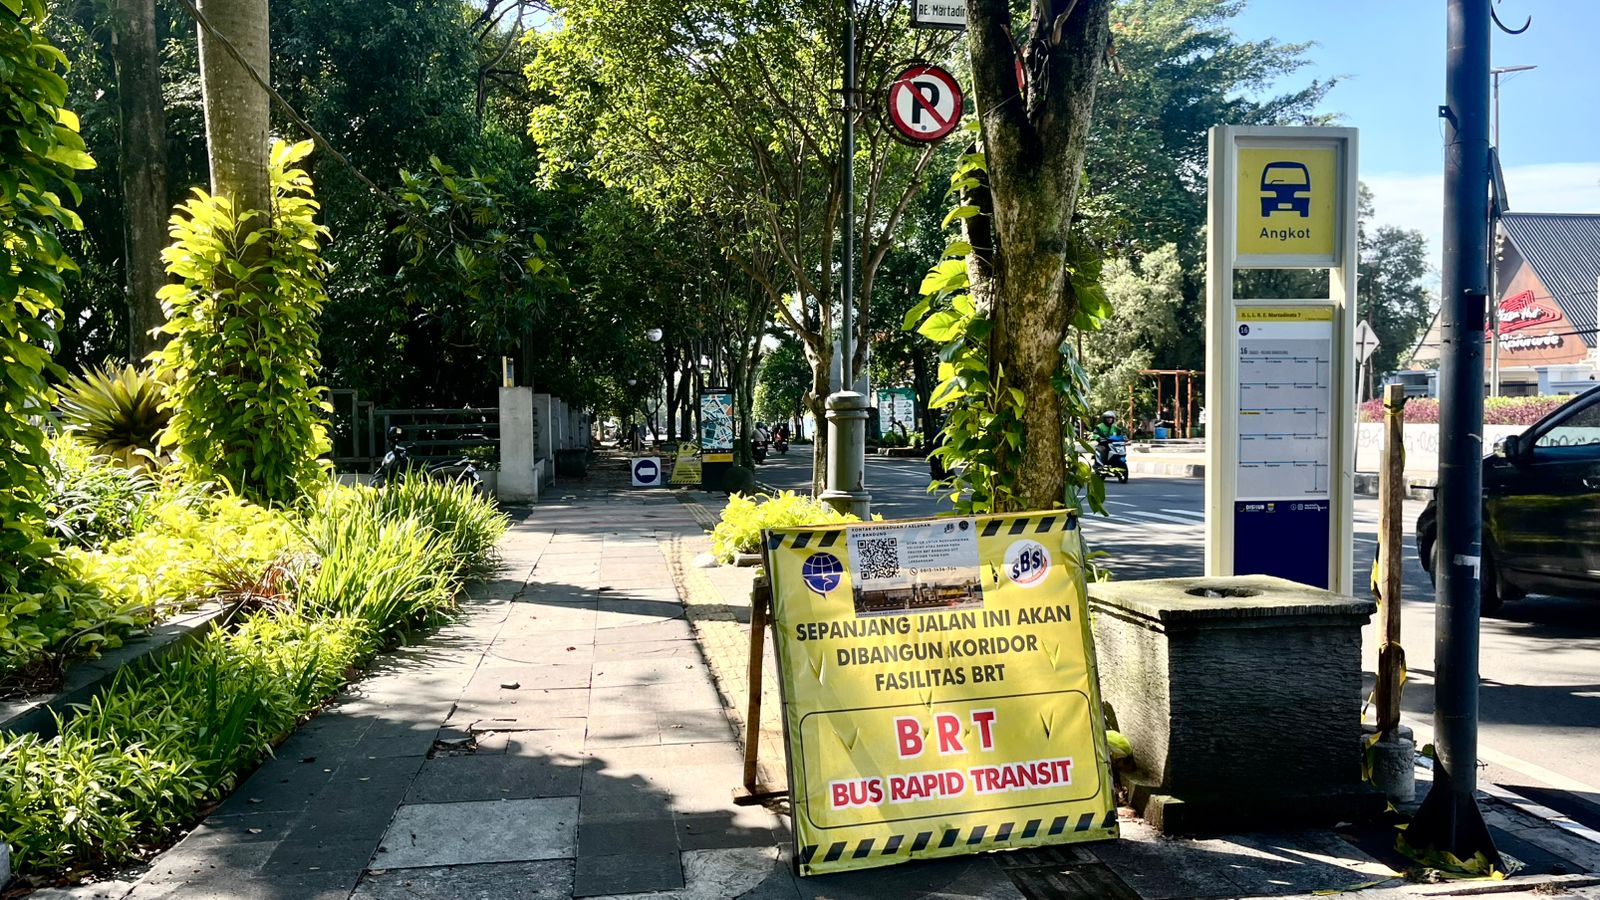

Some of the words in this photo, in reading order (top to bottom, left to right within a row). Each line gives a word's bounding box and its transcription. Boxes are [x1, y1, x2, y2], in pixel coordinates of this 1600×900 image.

[1259, 227, 1311, 241] Angkot
[1240, 347, 1248, 355] 16
[1012, 550, 1041, 579] SBS
[796, 616, 911, 641] SEPANJANG
[916, 612, 976, 633] JALAN
[983, 609, 1010, 628] INI
[1017, 605, 1071, 625] AKAN
[836, 641, 943, 666] DIBANGUN
[949, 634, 1038, 658] KORIDOR
[875, 666, 965, 691] FASILITAS
[972, 663, 1005, 683] BRT
[832, 779, 883, 807] BUS
[890, 771, 964, 800] RAPID
[970, 760, 1071, 792] TRANSIT
